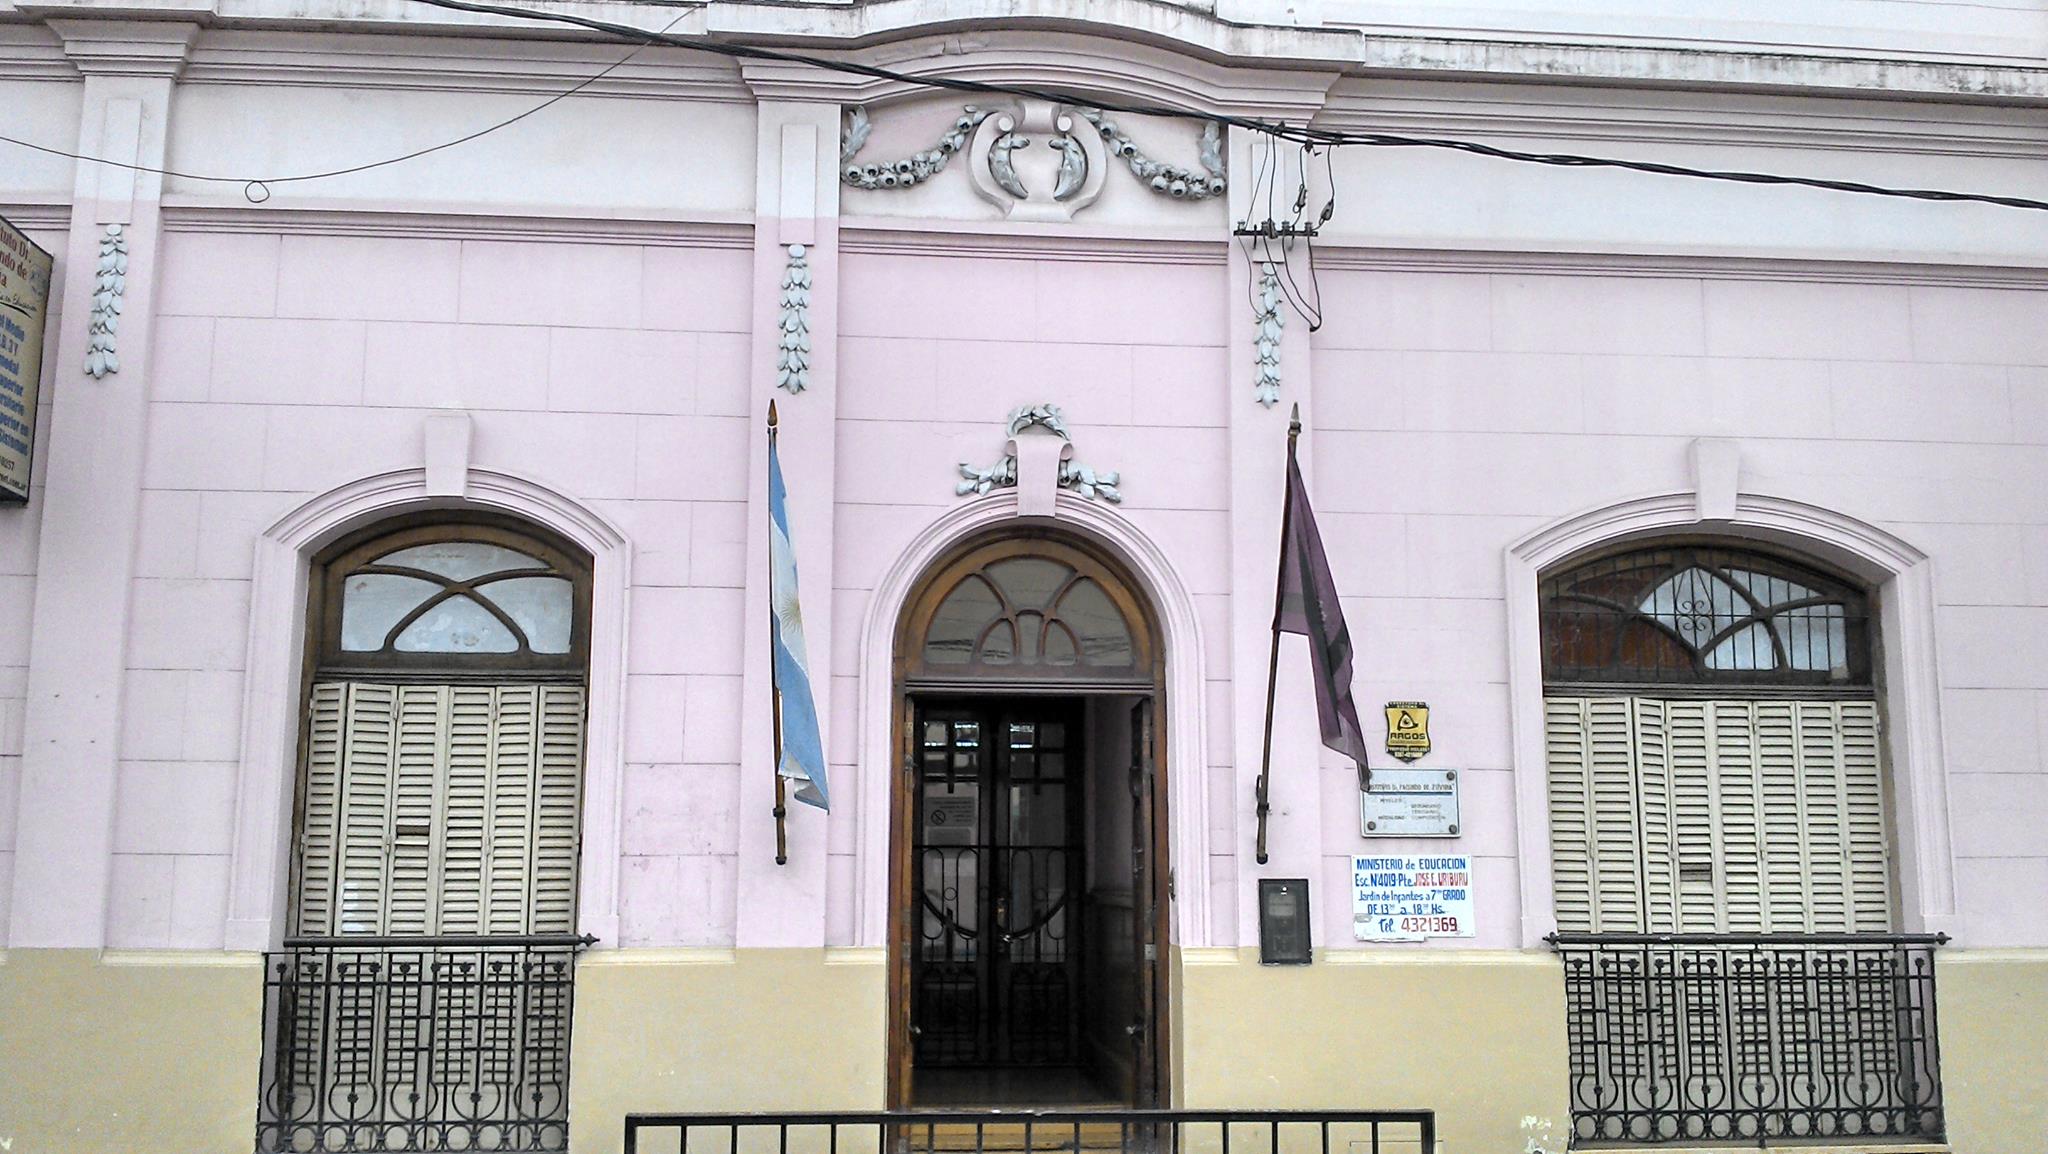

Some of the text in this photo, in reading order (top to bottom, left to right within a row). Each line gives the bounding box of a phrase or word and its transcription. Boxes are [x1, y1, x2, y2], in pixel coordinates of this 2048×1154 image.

[1390, 732, 1426, 745] ARGOS
[1356, 858, 1466, 870] MINISTERIO de EDUCACION
[1381, 890, 1390, 901] de
[1367, 904, 1378, 915] DE
[1400, 906, 1408, 915] a
[1401, 917, 1458, 933] 4321369
